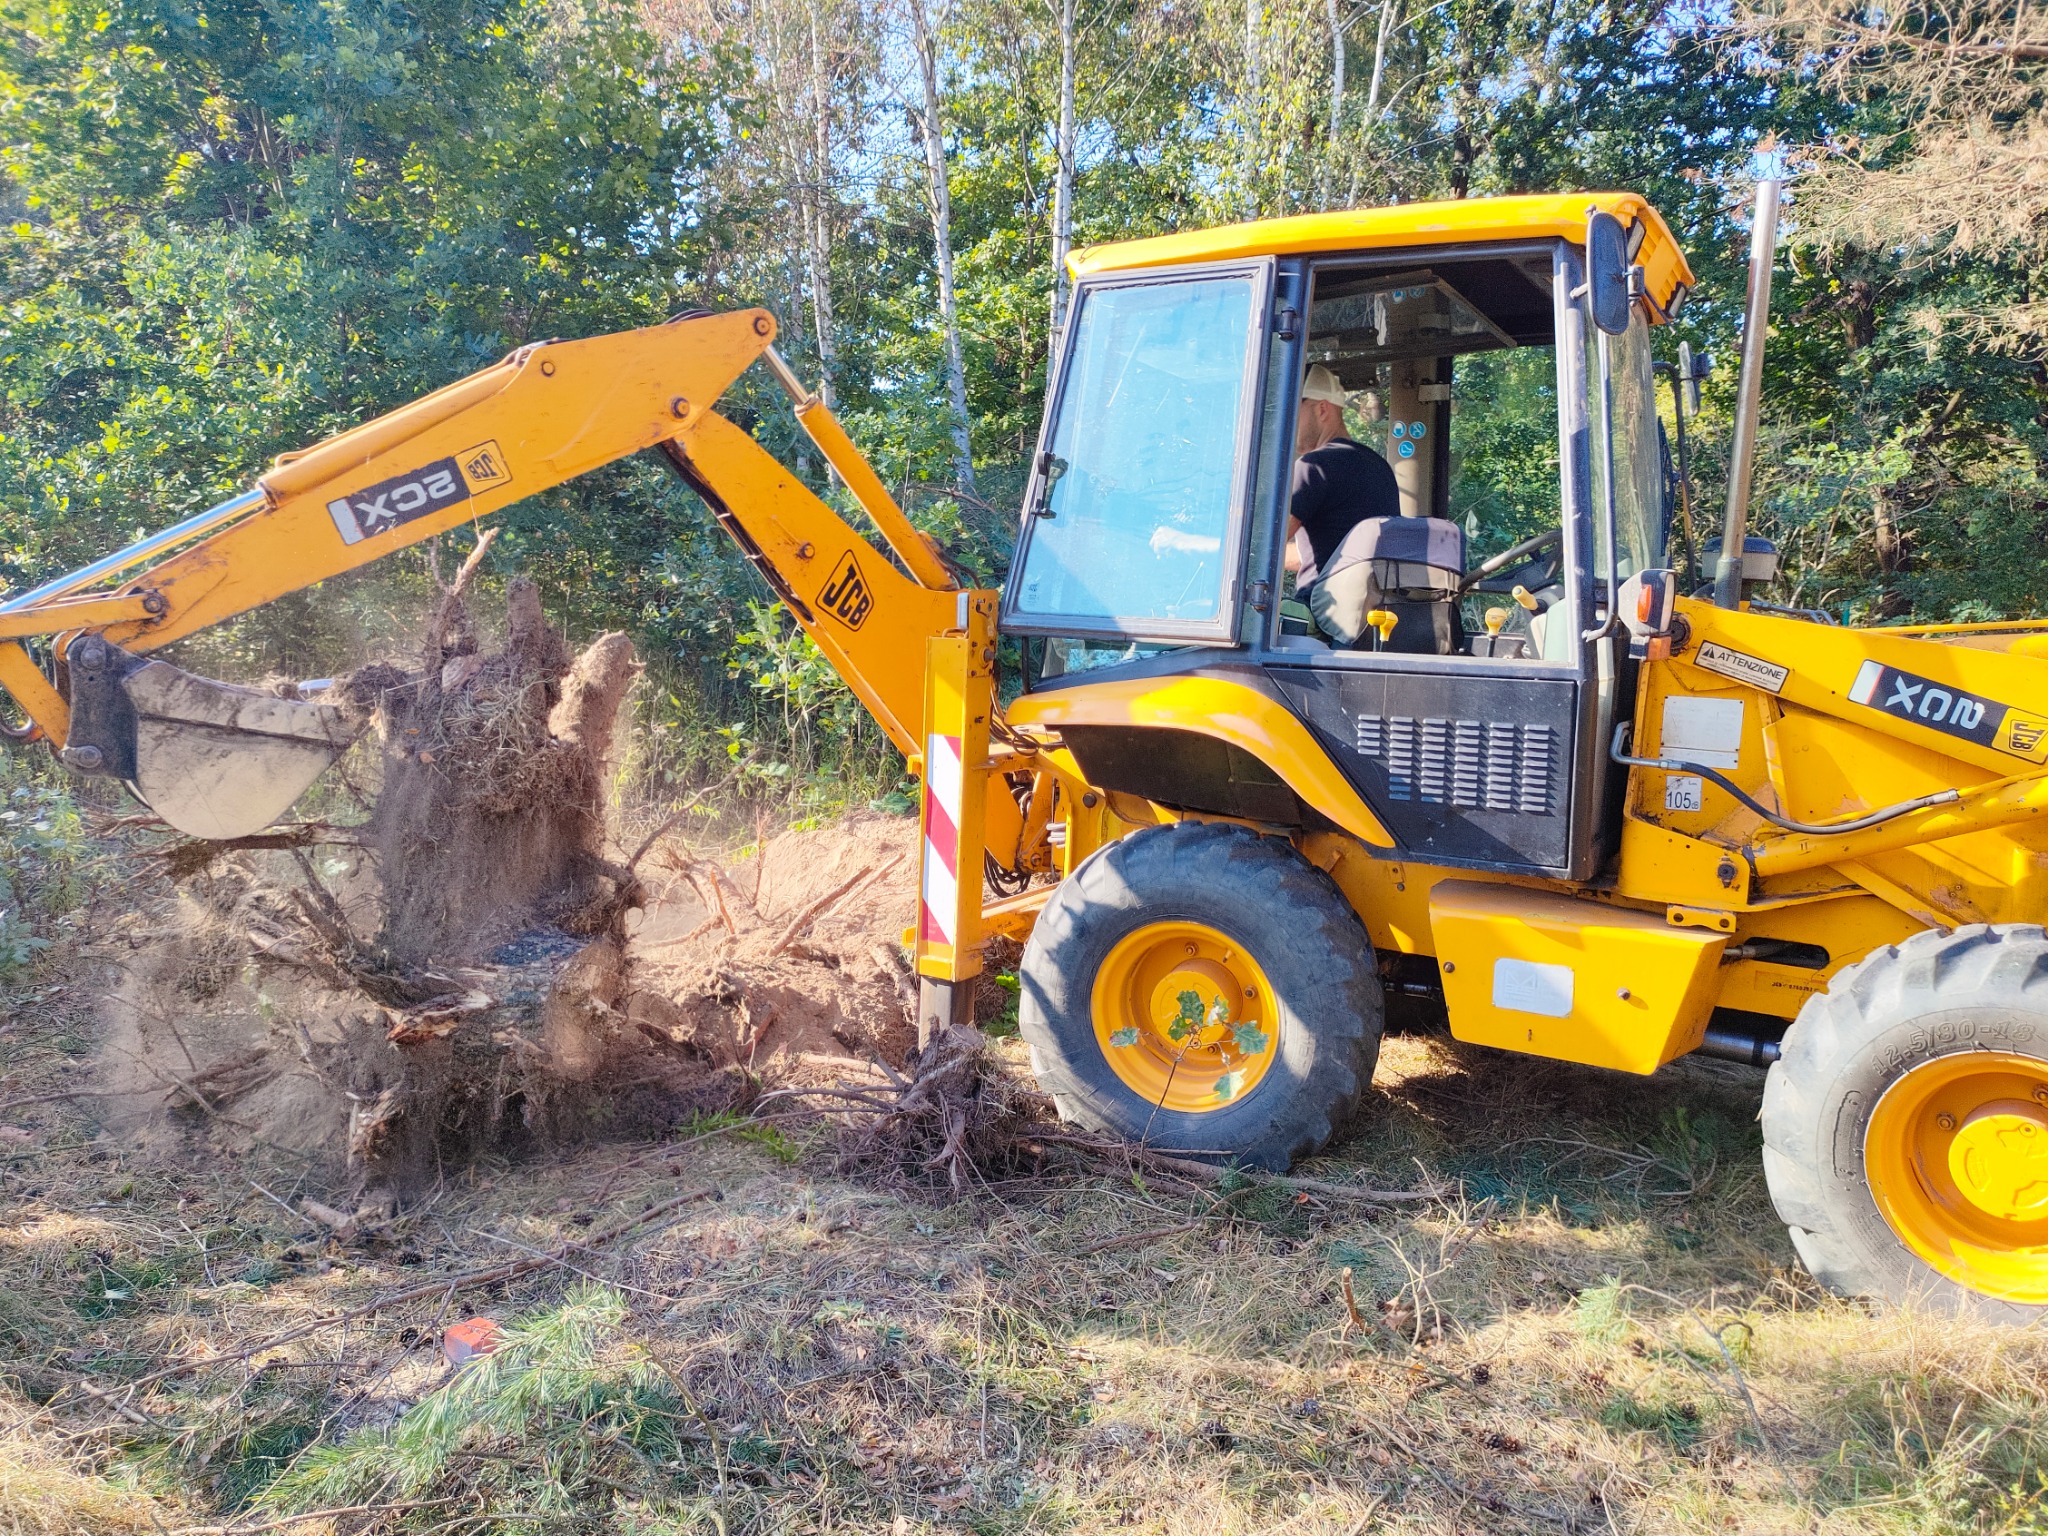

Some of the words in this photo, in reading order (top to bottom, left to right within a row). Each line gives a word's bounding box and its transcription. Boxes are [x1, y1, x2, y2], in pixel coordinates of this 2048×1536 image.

[467, 453, 498, 480] JCB
[355, 469, 457, 527] 2CX
[822, 563, 870, 626] JCB
[1717, 651, 1784, 681] ATTENZIONE
[1885, 675, 1985, 730] 2CX
[2011, 722, 2046, 750] JCB
[1667, 791, 1692, 809] 105
[1871, 1018, 2037, 1077] 12.5/80-18
